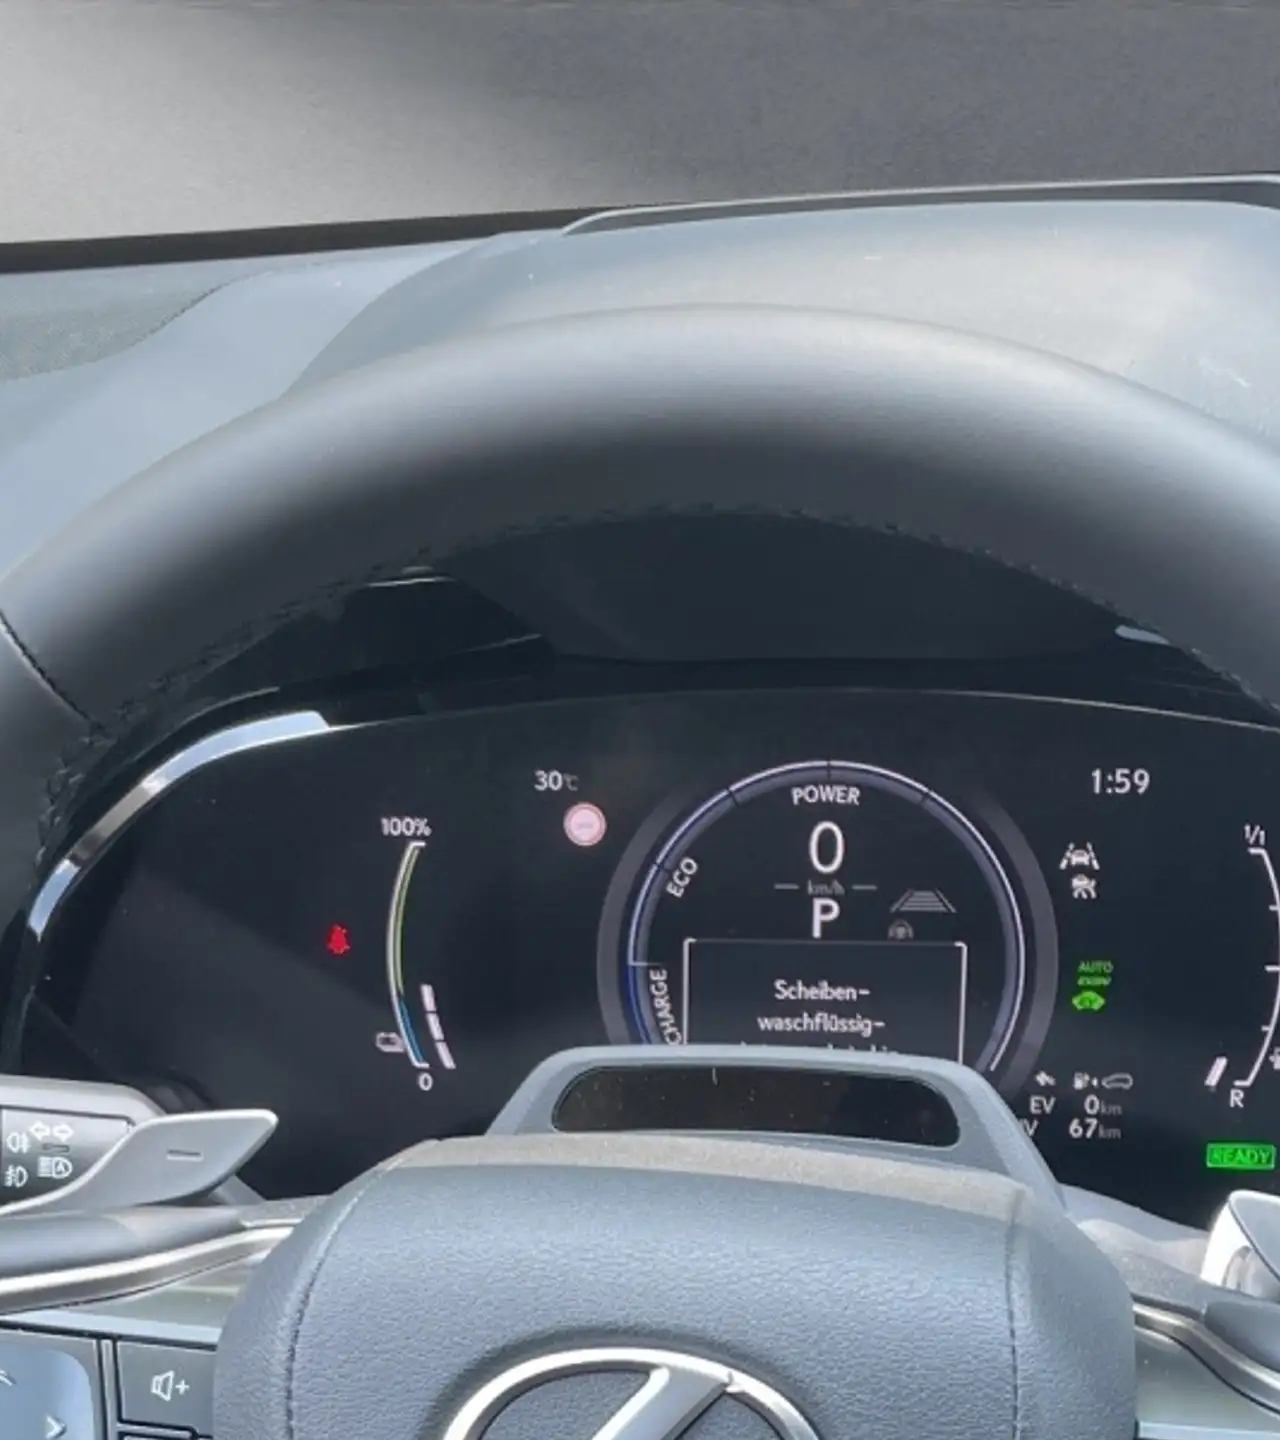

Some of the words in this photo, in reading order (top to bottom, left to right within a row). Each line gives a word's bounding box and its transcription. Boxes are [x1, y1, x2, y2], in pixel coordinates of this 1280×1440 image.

[1090, 768, 1151, 795] 1:59
[791, 784, 862, 806] POWER
[381, 817, 432, 837] 100%
[1243, 824, 1266, 846] 1/1
[808, 820, 845, 874] 0
[666, 857, 699, 898] ECO
[806, 879, 846, 896] km/h
[811, 897, 841, 940] P
[773, 978, 871, 1001] Scheiben-
[417, 1072, 434, 1092] 0
[1029, 1095, 1057, 1114] EV
[1229, 1089, 1245, 1109] R
[1212, 1146, 1271, 1165] READY
